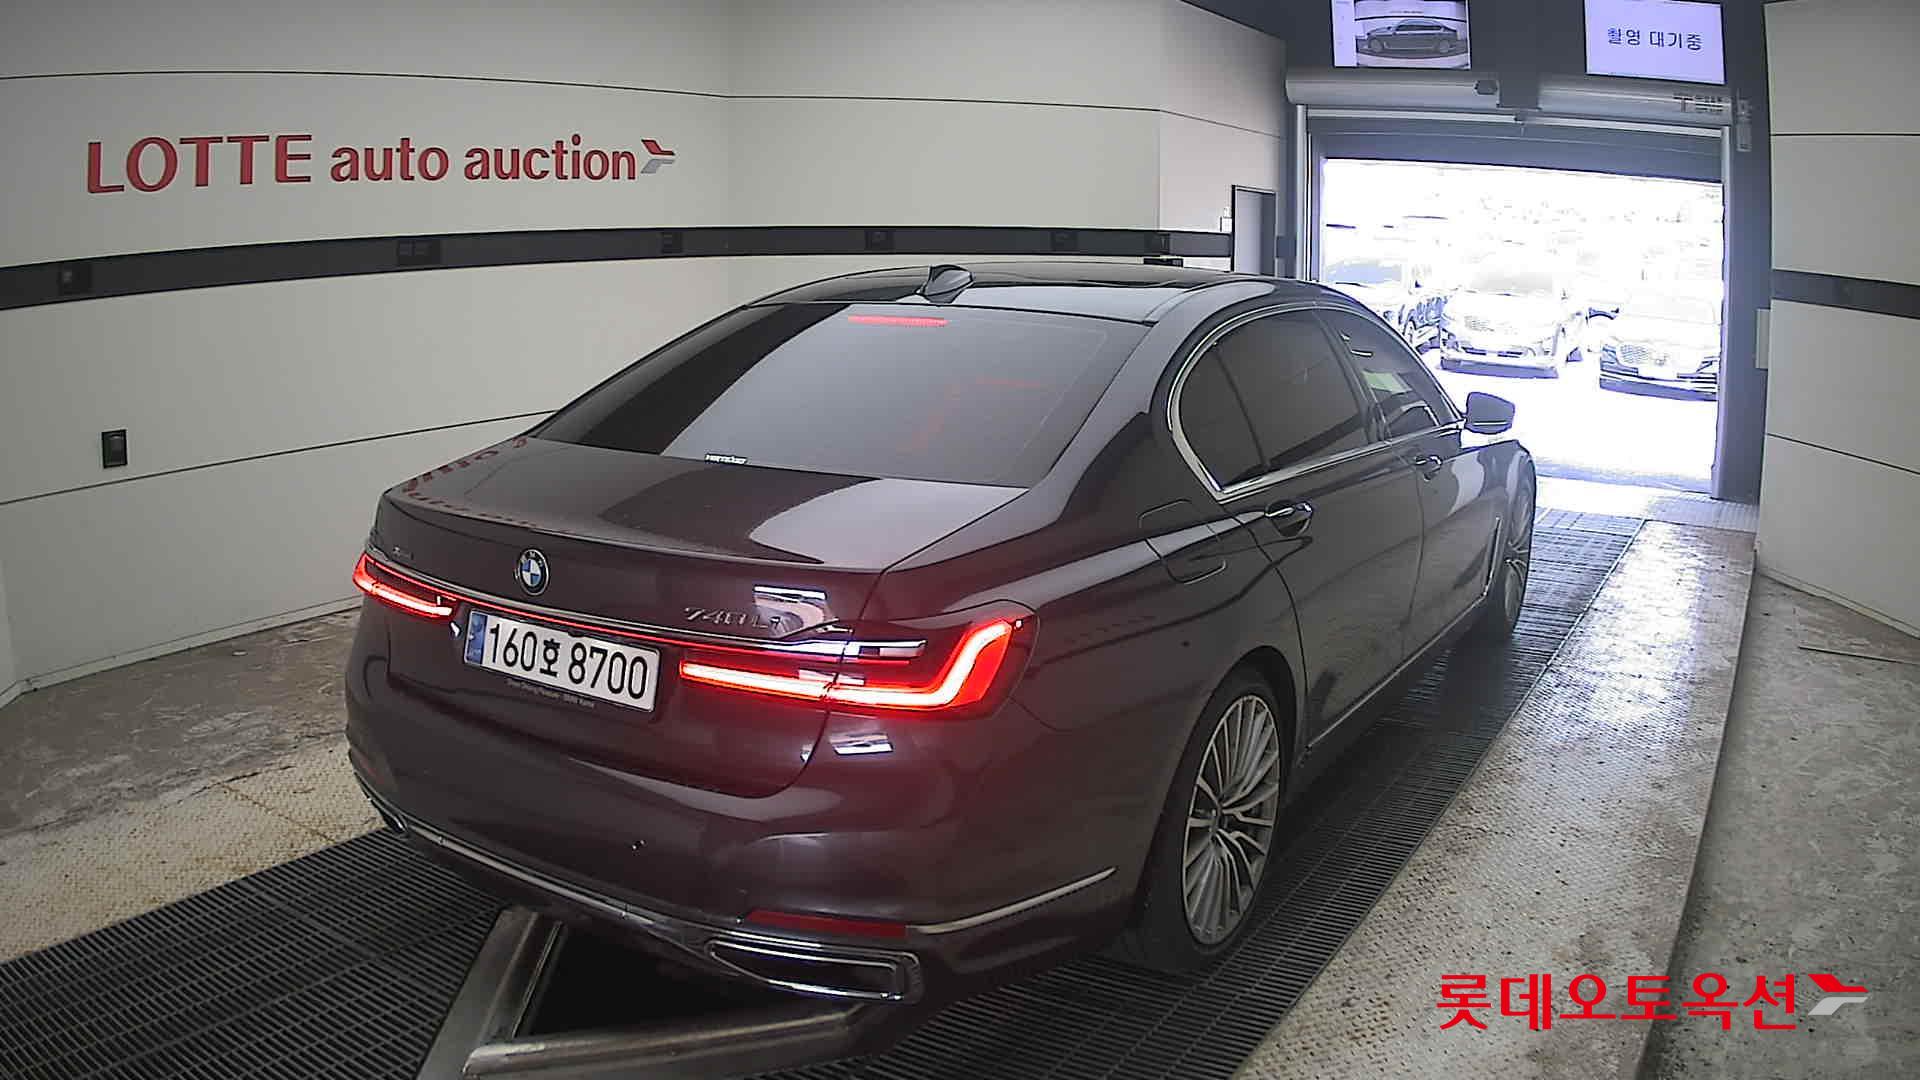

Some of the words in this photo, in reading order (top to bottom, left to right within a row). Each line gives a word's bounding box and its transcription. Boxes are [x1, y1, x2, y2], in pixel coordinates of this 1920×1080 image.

[1607, 27, 1641, 46] 촬영
[1649, 30, 1702, 51] 대기중
[87, 134, 312, 194] LOTTE
[331, 138, 451, 182] auto
[464, 134, 637, 180] auction
[489, 623, 561, 678] 160호
[567, 642, 648, 699] 8700
